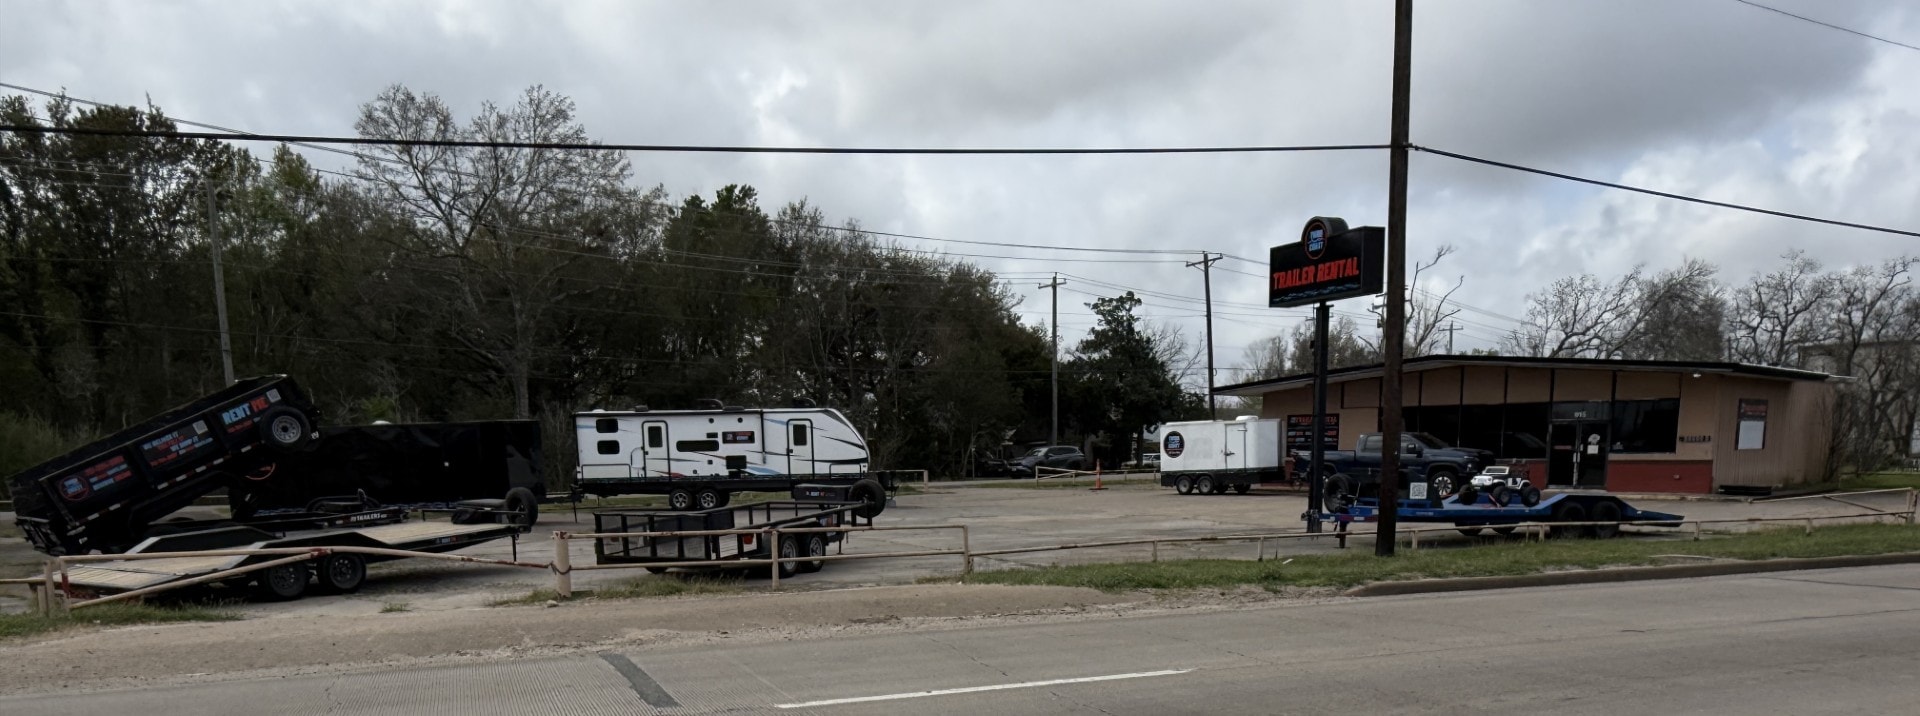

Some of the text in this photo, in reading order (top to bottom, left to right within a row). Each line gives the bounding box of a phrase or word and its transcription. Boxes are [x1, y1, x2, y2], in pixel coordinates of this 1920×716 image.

[1273, 256, 1360, 289] TRAILER RENTAL
[222, 402, 251, 425] RENT
